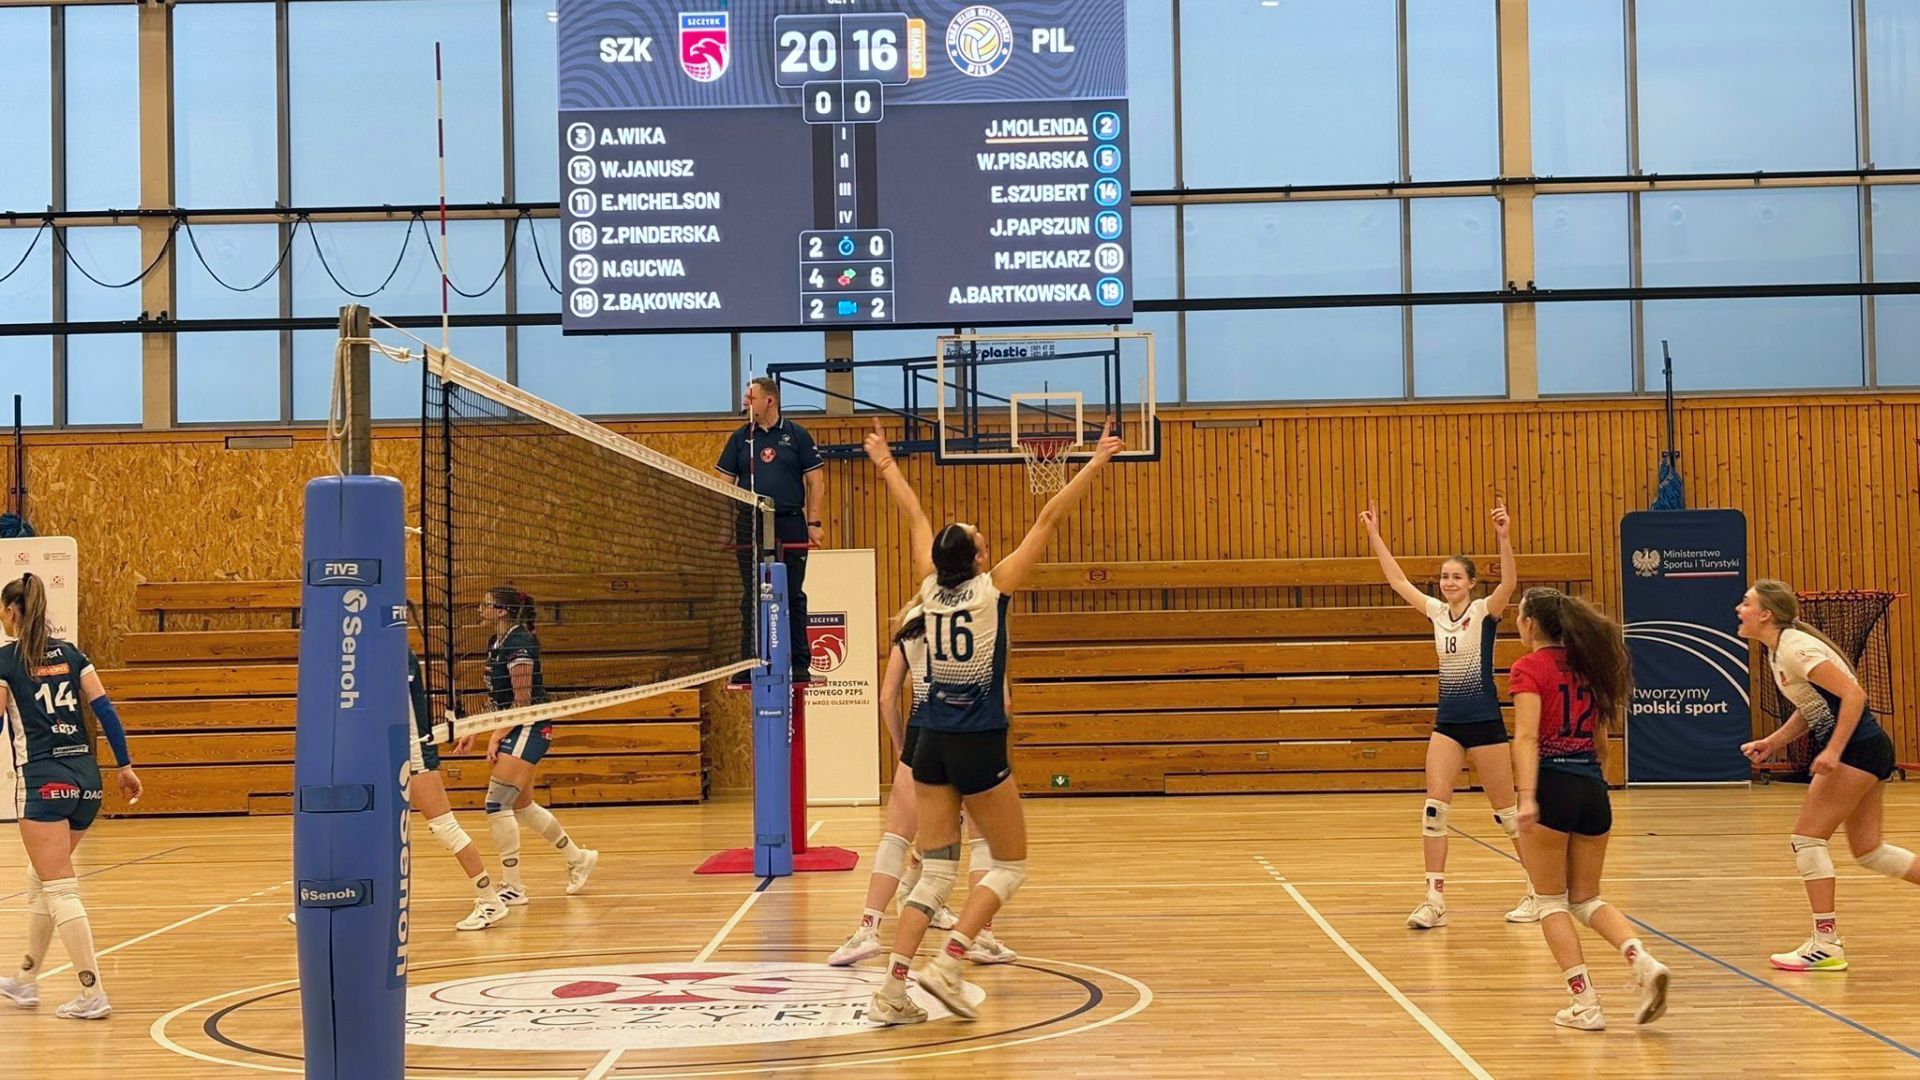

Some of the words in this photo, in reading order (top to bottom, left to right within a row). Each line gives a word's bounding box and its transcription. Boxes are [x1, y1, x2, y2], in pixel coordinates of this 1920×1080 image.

[600, 37, 652, 62] SZK
[1032, 27, 1074, 53] PIL
[780, 31, 836, 72] 20
[853, 29, 898, 71] 16
[815, 91, 832, 114] 0
[855, 90, 871, 114] 0
[575, 128, 587, 144] 3
[600, 127, 666, 145] A.WIKA
[985, 117, 1088, 138] J.MOLENDA
[1101, 118, 1113, 133] 2
[573, 162, 590, 177] 13
[600, 159, 694, 178] W.JANUSZ
[976, 151, 1088, 170] W.PISARSKA
[1101, 150, 1113, 166] 5
[839, 182, 852, 196] III
[991, 184, 1089, 203] E.SZUBERT
[1099, 183, 1117, 200] 14
[575, 194, 590, 210] 11
[601, 192, 721, 211] E.MICHELSON
[839, 211, 853, 224] IV
[989, 217, 1090, 236] J.PAPSZUN
[574, 227, 592, 243] 16
[601, 225, 721, 244] Z.PINDERSKA
[809, 237, 823, 257] 2
[869, 236, 884, 256] 0
[575, 261, 593, 277] 12
[602, 259, 685, 278] N.GUCWA
[994, 250, 1091, 269] M.PIEKARZ
[1101, 250, 1117, 266] 18
[809, 268, 824, 288] 4
[870, 267, 885, 287] 6
[575, 294, 593, 311] 18
[602, 292, 721, 314] Z.BĄKOWSKA
[949, 284, 1092, 304] A.BARTKOWSKA
[810, 299, 824, 319] 2
[870, 298, 885, 318] 2
[1663, 549, 1720, 558] Ministerstwo
[325, 563, 358, 575] FIVB
[1663, 560, 1692, 570] Sportu
[1694, 559, 1698, 568] i
[1700, 558, 1740, 569] Turystyki
[771, 613, 779, 648] Senoh
[931, 609, 974, 662] 16
[1445, 636, 1457, 654] 18
[340, 616, 363, 709] Senoh
[34, 680, 77, 715] 14
[1633, 687, 1711, 700] tworzymy
[1558, 683, 1596, 738] 12
[1633, 701, 1681, 716] polski
[1685, 701, 1728, 716] sport
[309, 887, 356, 901] Senoh
[396, 808, 410, 977] Senoh
[407, 1006, 599, 1016] CENTRALNY
